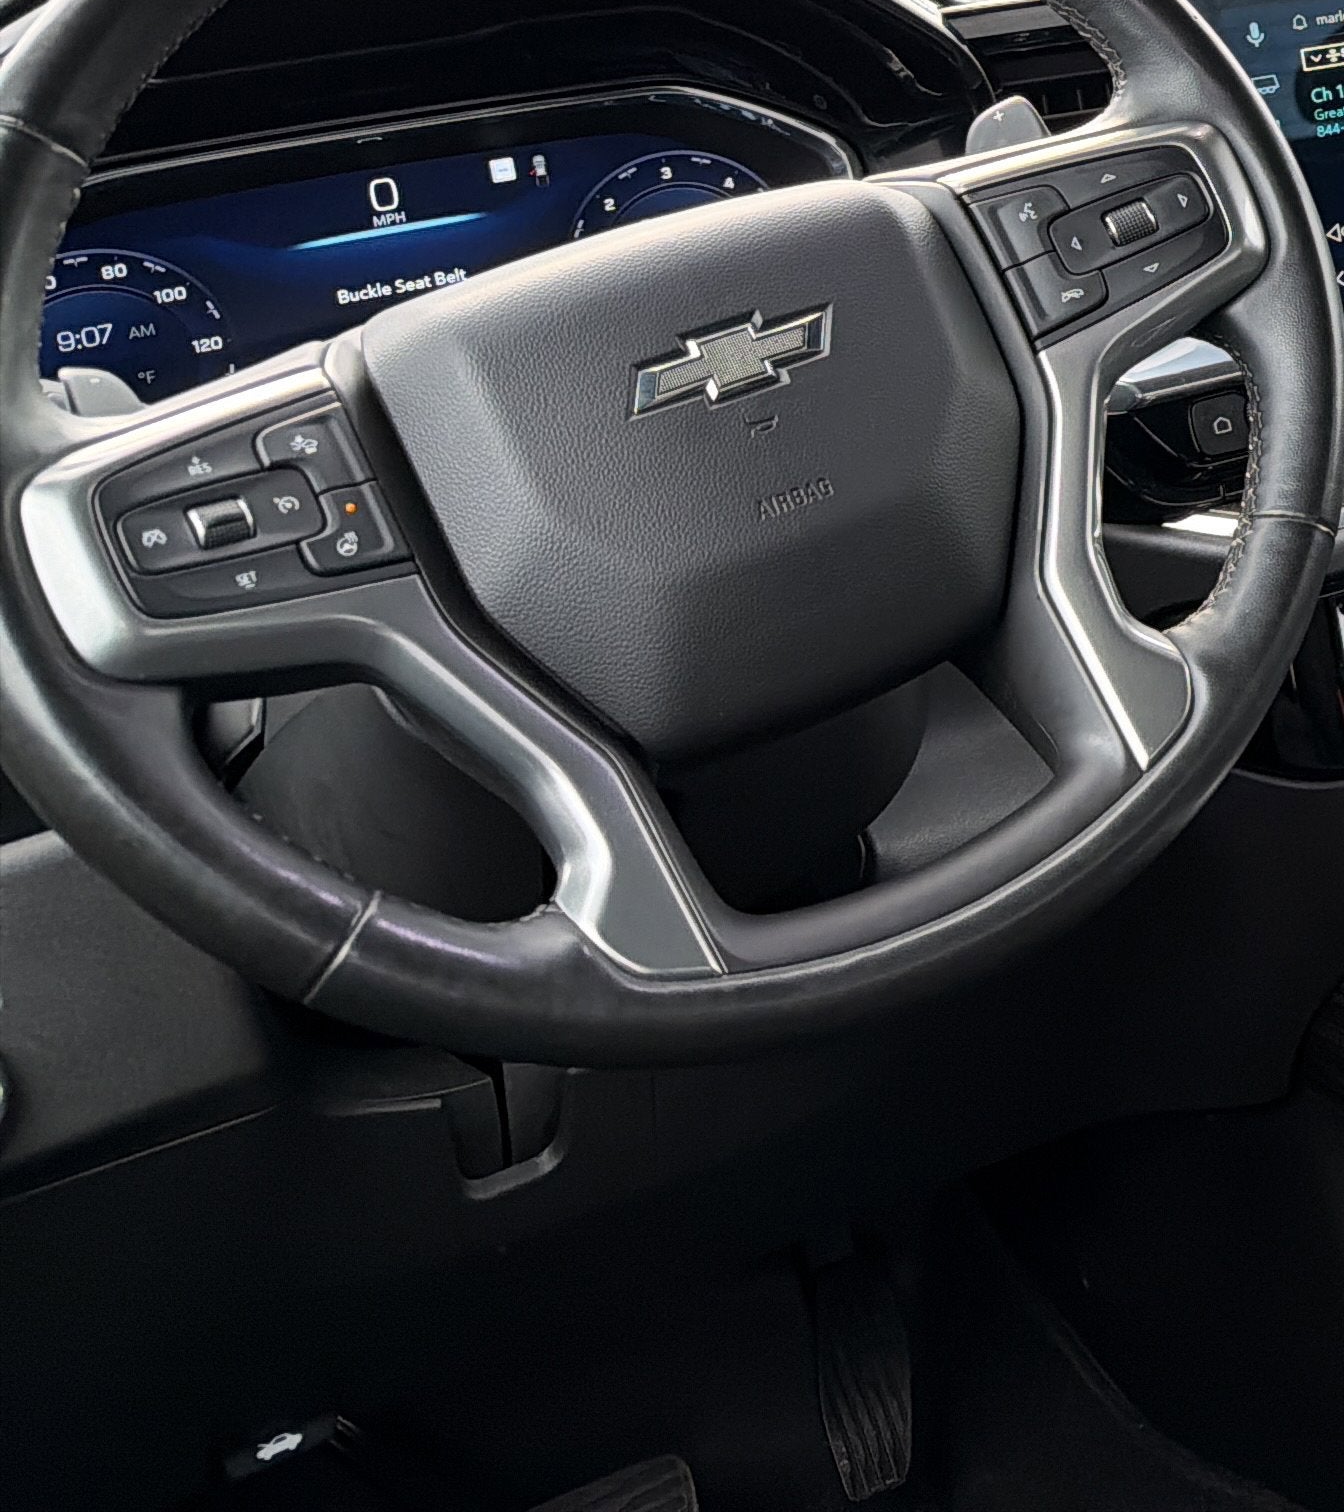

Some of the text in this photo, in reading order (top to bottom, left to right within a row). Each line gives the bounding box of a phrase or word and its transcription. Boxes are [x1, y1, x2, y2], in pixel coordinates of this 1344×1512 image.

[1310, 87, 1333, 103] Ch
[1336, 84, 1344, 99] 1
[660, 166, 673, 180] 3
[722, 176, 735, 189] 4
[369, 176, 400, 212] 0
[602, 197, 617, 212] 2
[372, 211, 407, 228] MPH
[100, 262, 128, 280] 80
[153, 286, 187, 304] 100
[336, 267, 467, 305] Buckle Seat Belt
[56, 322, 156, 353] 9:07 AM
[191, 335, 223, 354] 120
[758, 476, 835, 521] AIRBAG
